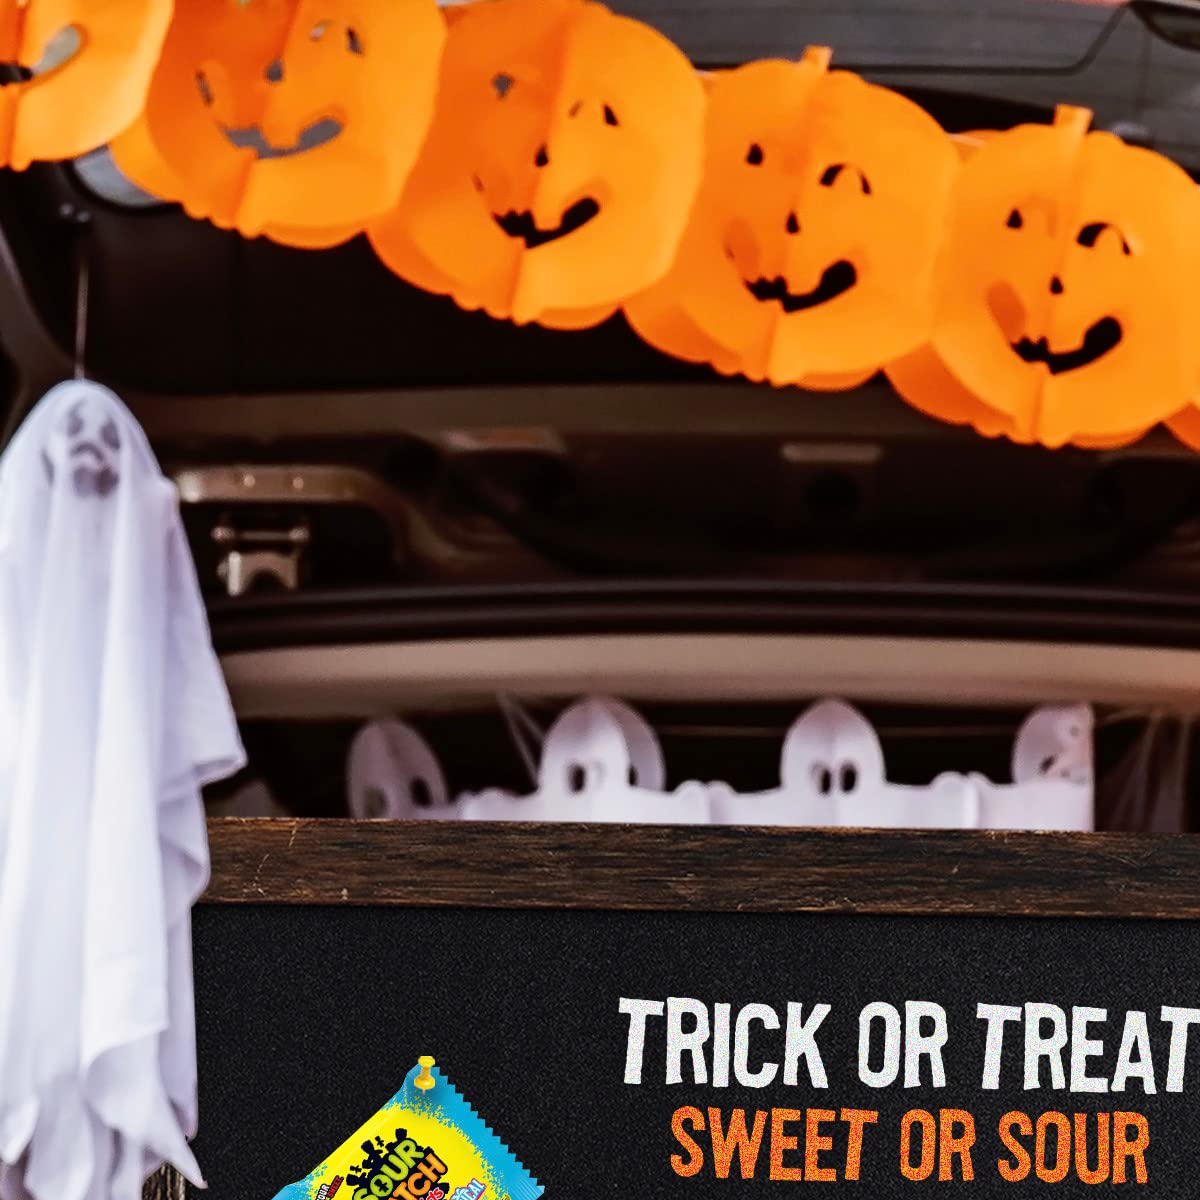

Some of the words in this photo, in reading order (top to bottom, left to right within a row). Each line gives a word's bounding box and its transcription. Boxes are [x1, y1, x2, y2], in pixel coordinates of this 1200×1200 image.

[618, 997, 832, 1088] TRICK
[858, 1001, 948, 1088] OR
[671, 1106, 878, 1181] SWEET
[900, 1108, 976, 1182] OR
[998, 1110, 1150, 1184] SOUR
